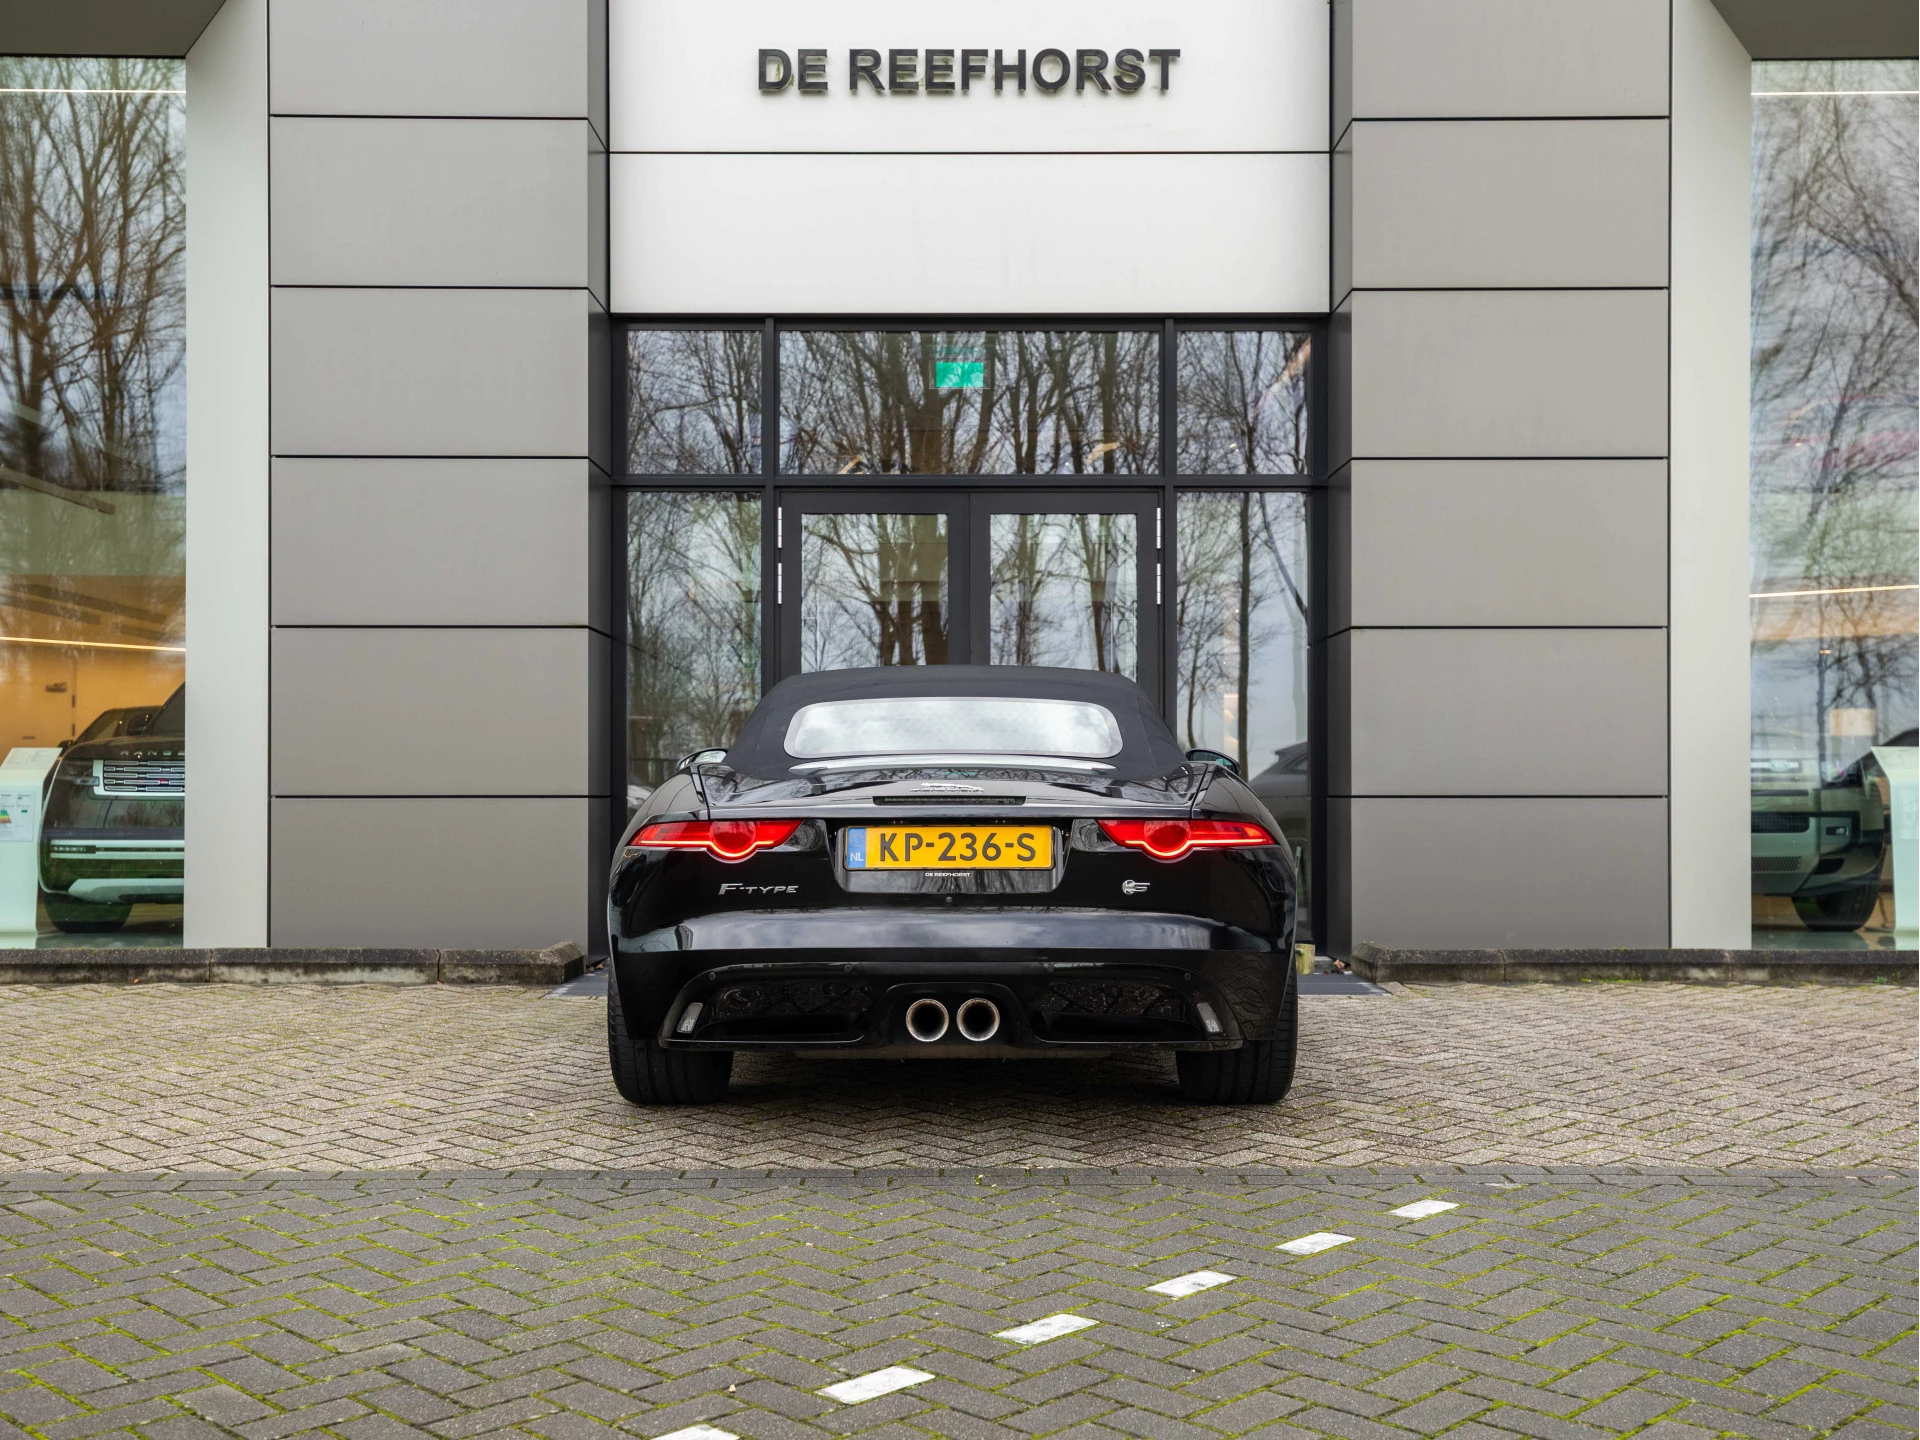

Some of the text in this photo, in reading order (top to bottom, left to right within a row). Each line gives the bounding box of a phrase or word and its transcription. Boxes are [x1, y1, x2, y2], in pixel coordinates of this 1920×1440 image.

[758, 48, 1181, 92] DE REEFHORST
[850, 852, 864, 863] NL
[879, 832, 1036, 862] KP-236-S
[718, 883, 799, 896] F-TYPE
